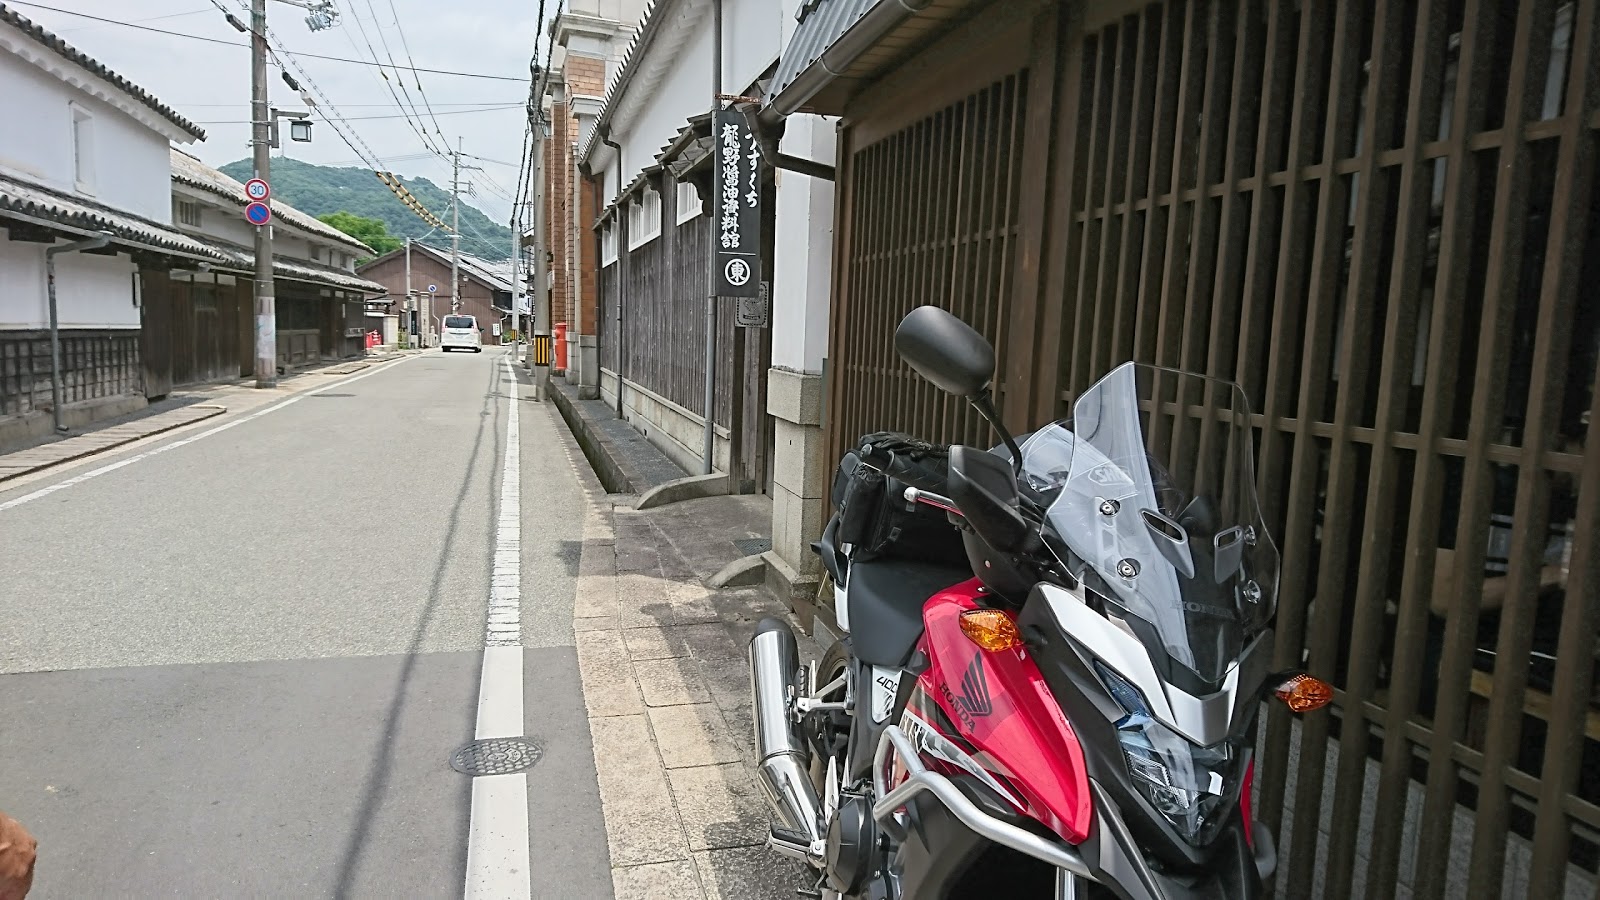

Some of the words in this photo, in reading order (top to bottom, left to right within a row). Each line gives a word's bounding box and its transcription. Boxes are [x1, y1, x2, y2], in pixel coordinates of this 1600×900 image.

[250, 185, 264, 195] 30
[729, 261, 746, 283] 東
[939, 681, 976, 733] HONDA
